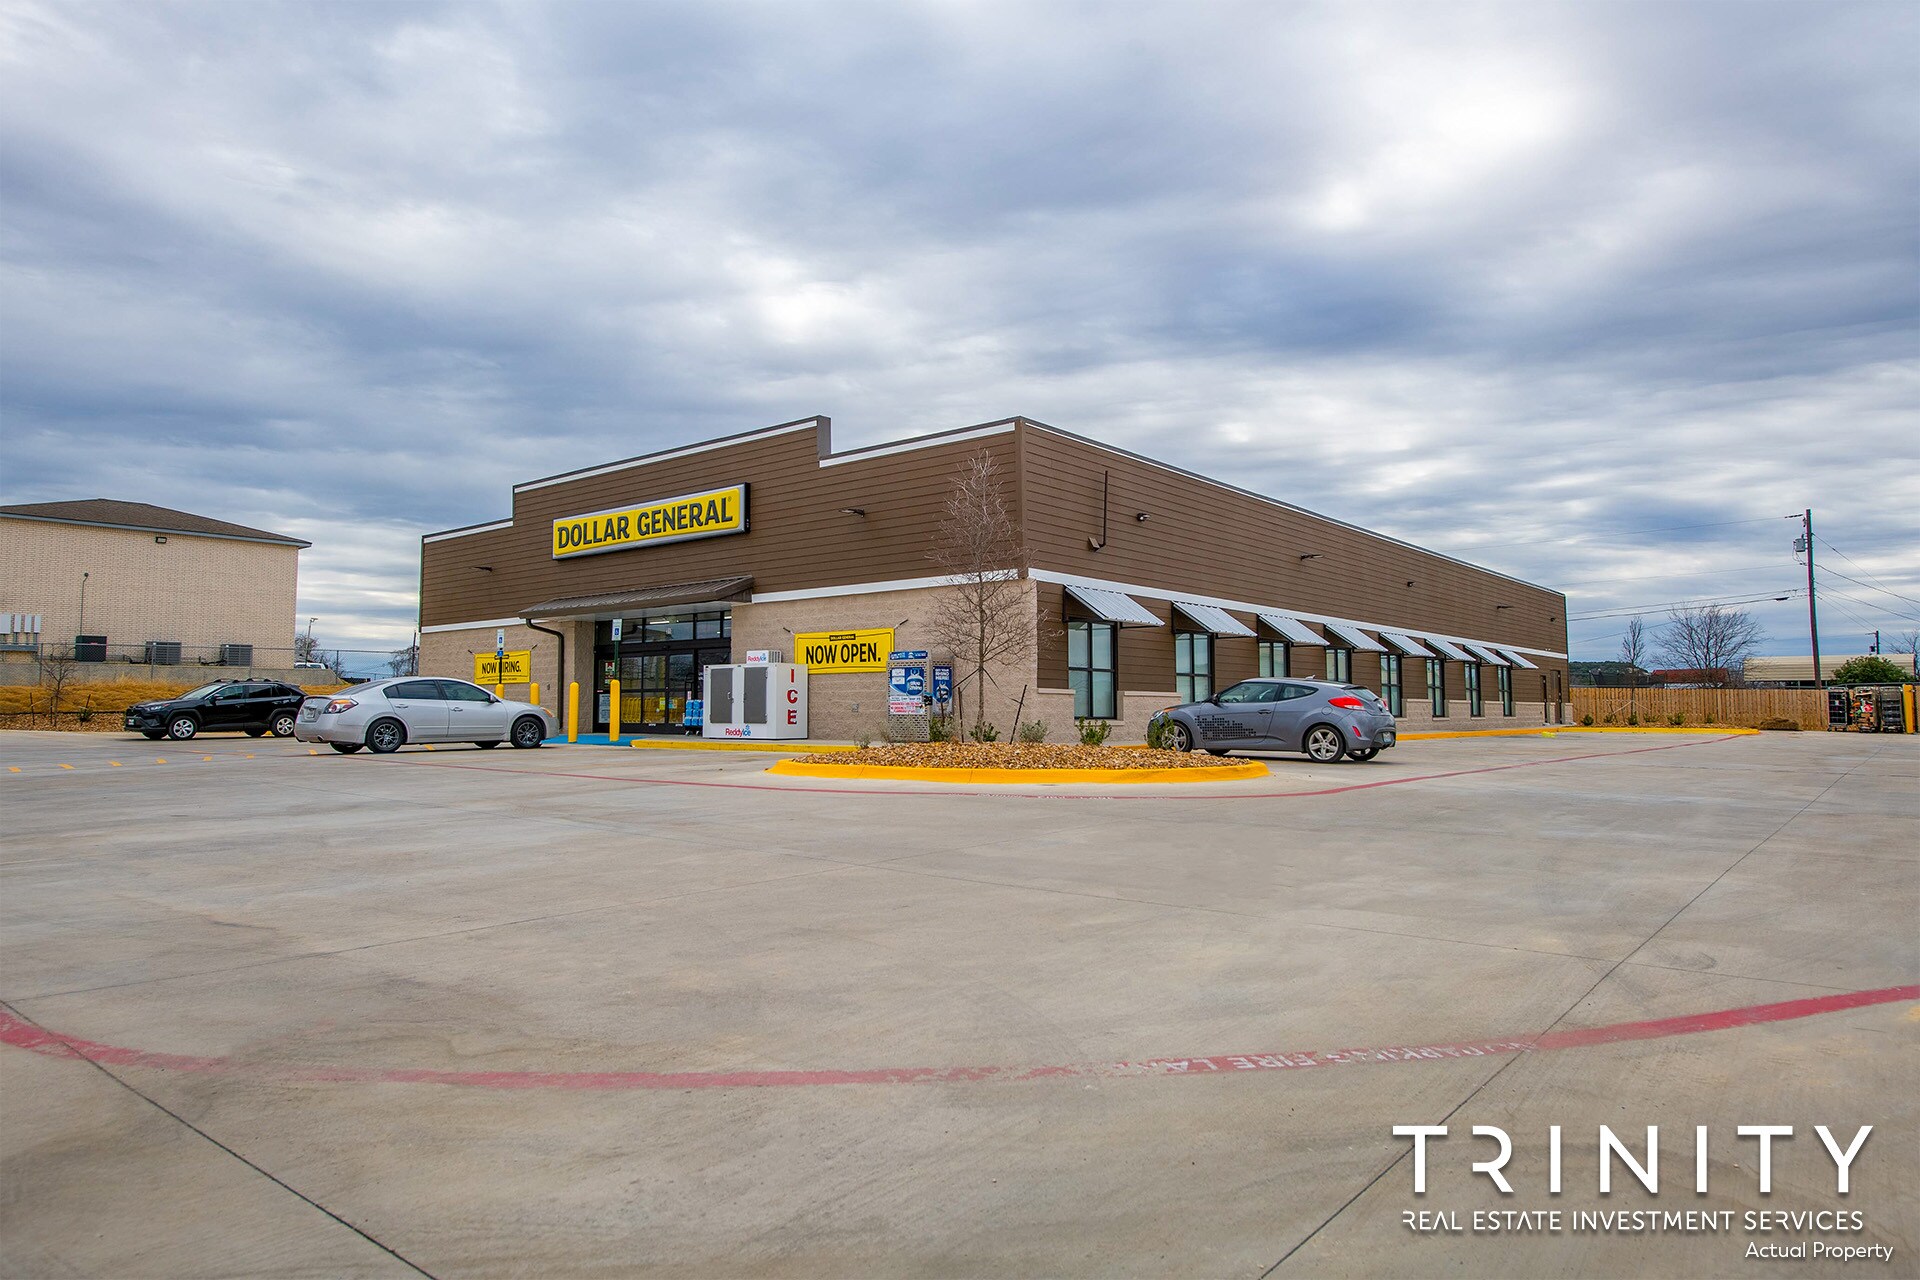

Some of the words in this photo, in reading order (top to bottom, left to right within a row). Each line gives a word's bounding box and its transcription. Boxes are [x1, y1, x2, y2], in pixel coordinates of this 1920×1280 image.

[558, 516, 629, 548] DOLLAR
[806, 644, 837, 664] NOW
[841, 642, 881, 664] OPEN.
[481, 662, 497, 674] NOW
[498, 660, 522, 673] IRING.
[786, 669, 798, 725] ICE
[1227, 1054, 1317, 1070] FIRE
